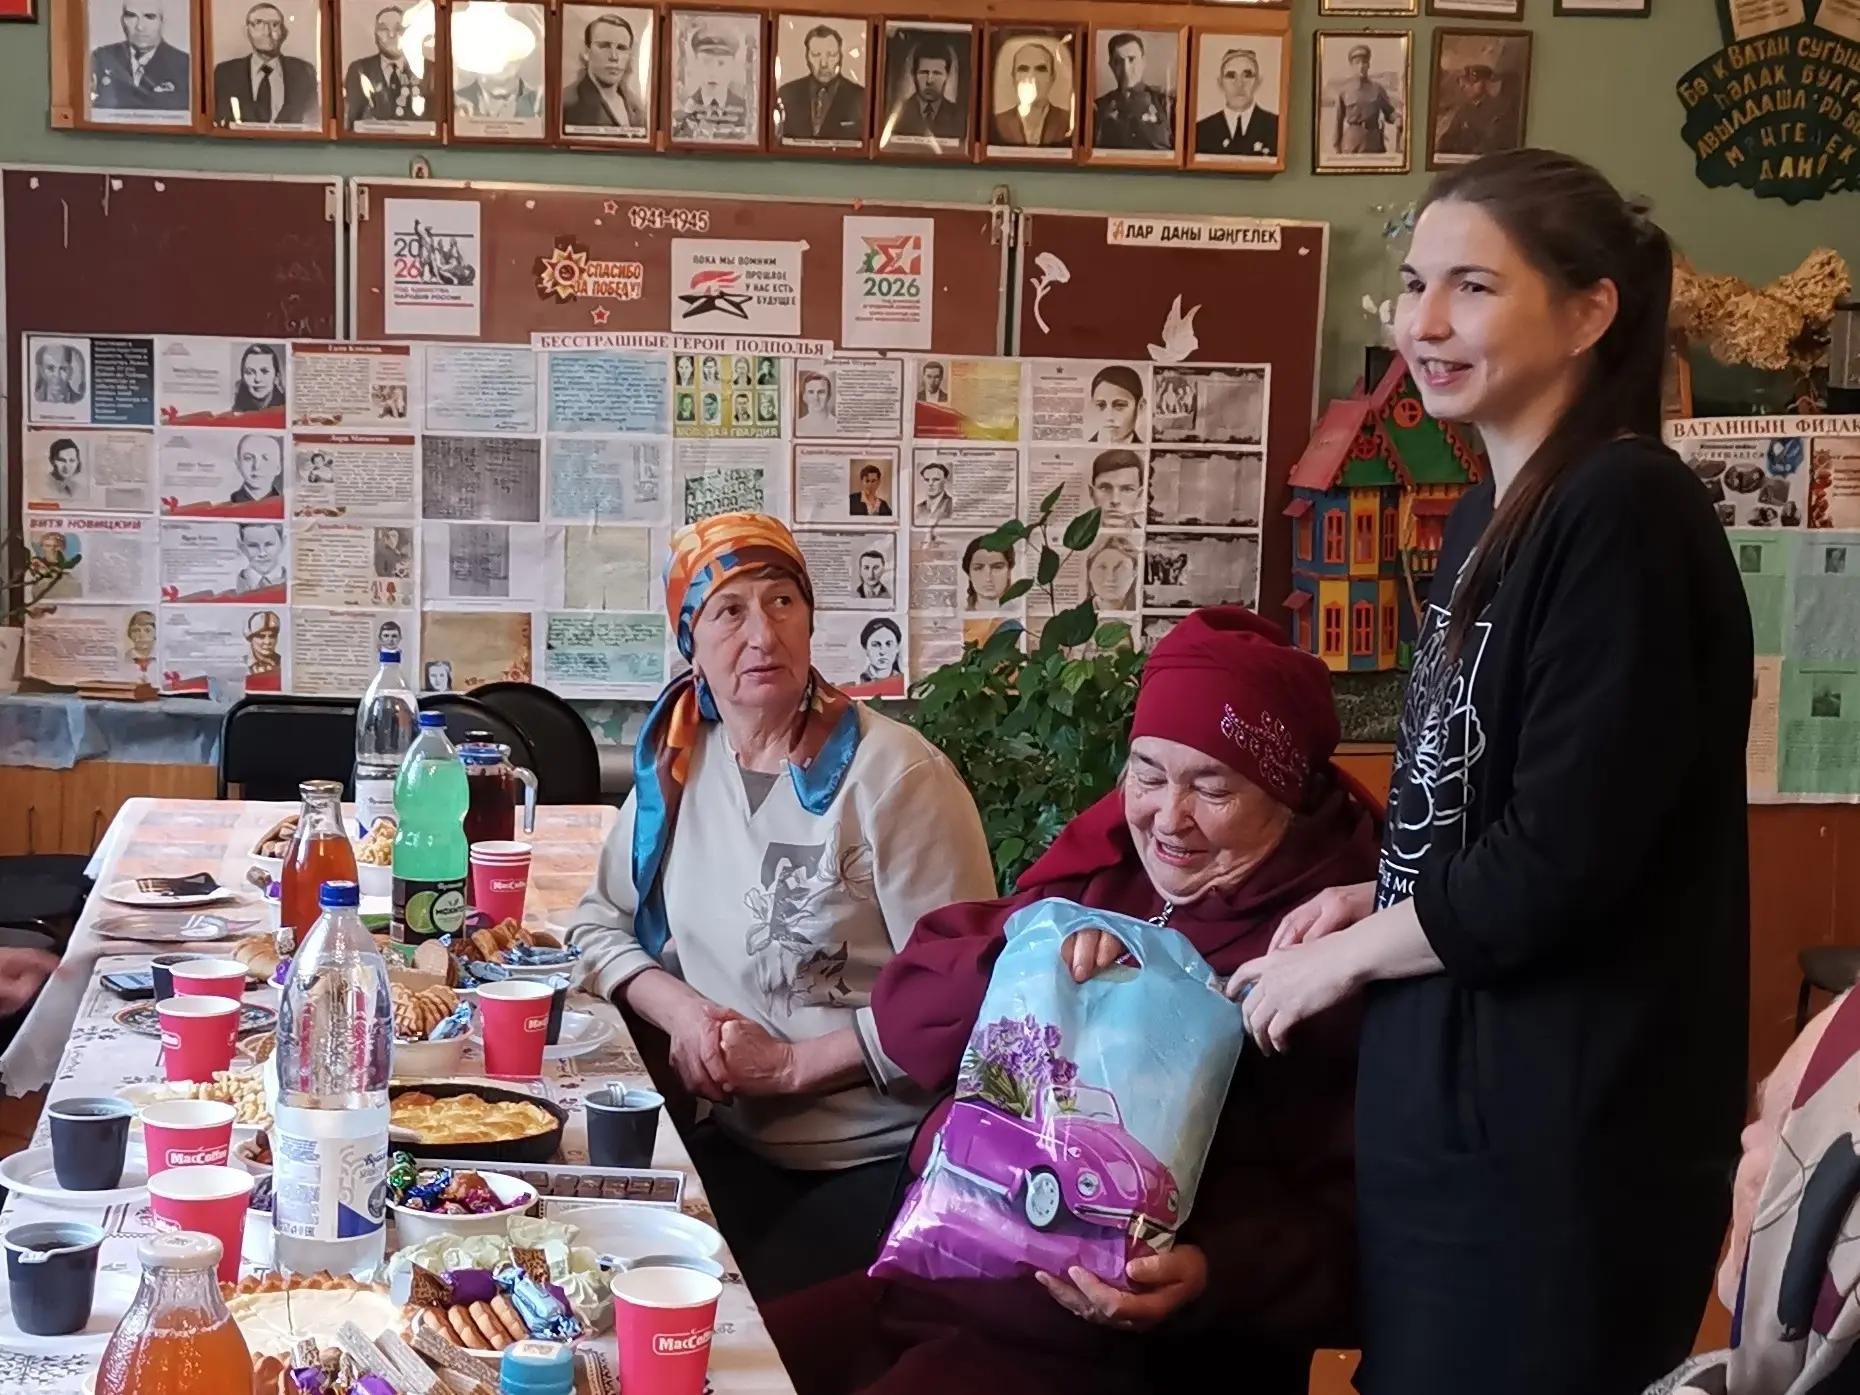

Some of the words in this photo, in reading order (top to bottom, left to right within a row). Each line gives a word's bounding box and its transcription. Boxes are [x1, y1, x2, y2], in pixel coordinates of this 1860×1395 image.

[1678, 58, 1728, 107] БӨК
[1728, 36, 1790, 69] ВАТАН
[629, 206, 710, 232] 1941-1945
[1113, 220, 1154, 241] АЛАР
[1160, 226, 1201, 242] ДАНЫ
[693, 255, 716, 265] ПОКА
[720, 255, 735, 265] МЫ
[738, 256, 777, 266] ПОМНИМ
[586, 263, 641, 279] СПАСИБО
[592, 281, 641, 299] ПОБЕДУ!
[754, 284, 770, 293] НАС
[773, 284, 794, 293] ЕСТЬ
[863, 277, 921, 298] 2026
[540, 335, 669, 348] БЕССТРАШНЫЕ
[673, 338, 726, 350] ГЕРОИ
[735, 340, 825, 356] ПОДПОЛЬЯ
[730, 426, 778, 438] ГВАРДИЯ
[1674, 418, 1787, 438] ВАТАННЫҢ
[29, 519, 63, 528] ВИТЯ
[67, 519, 142, 530] НОВИЦКИЙ
